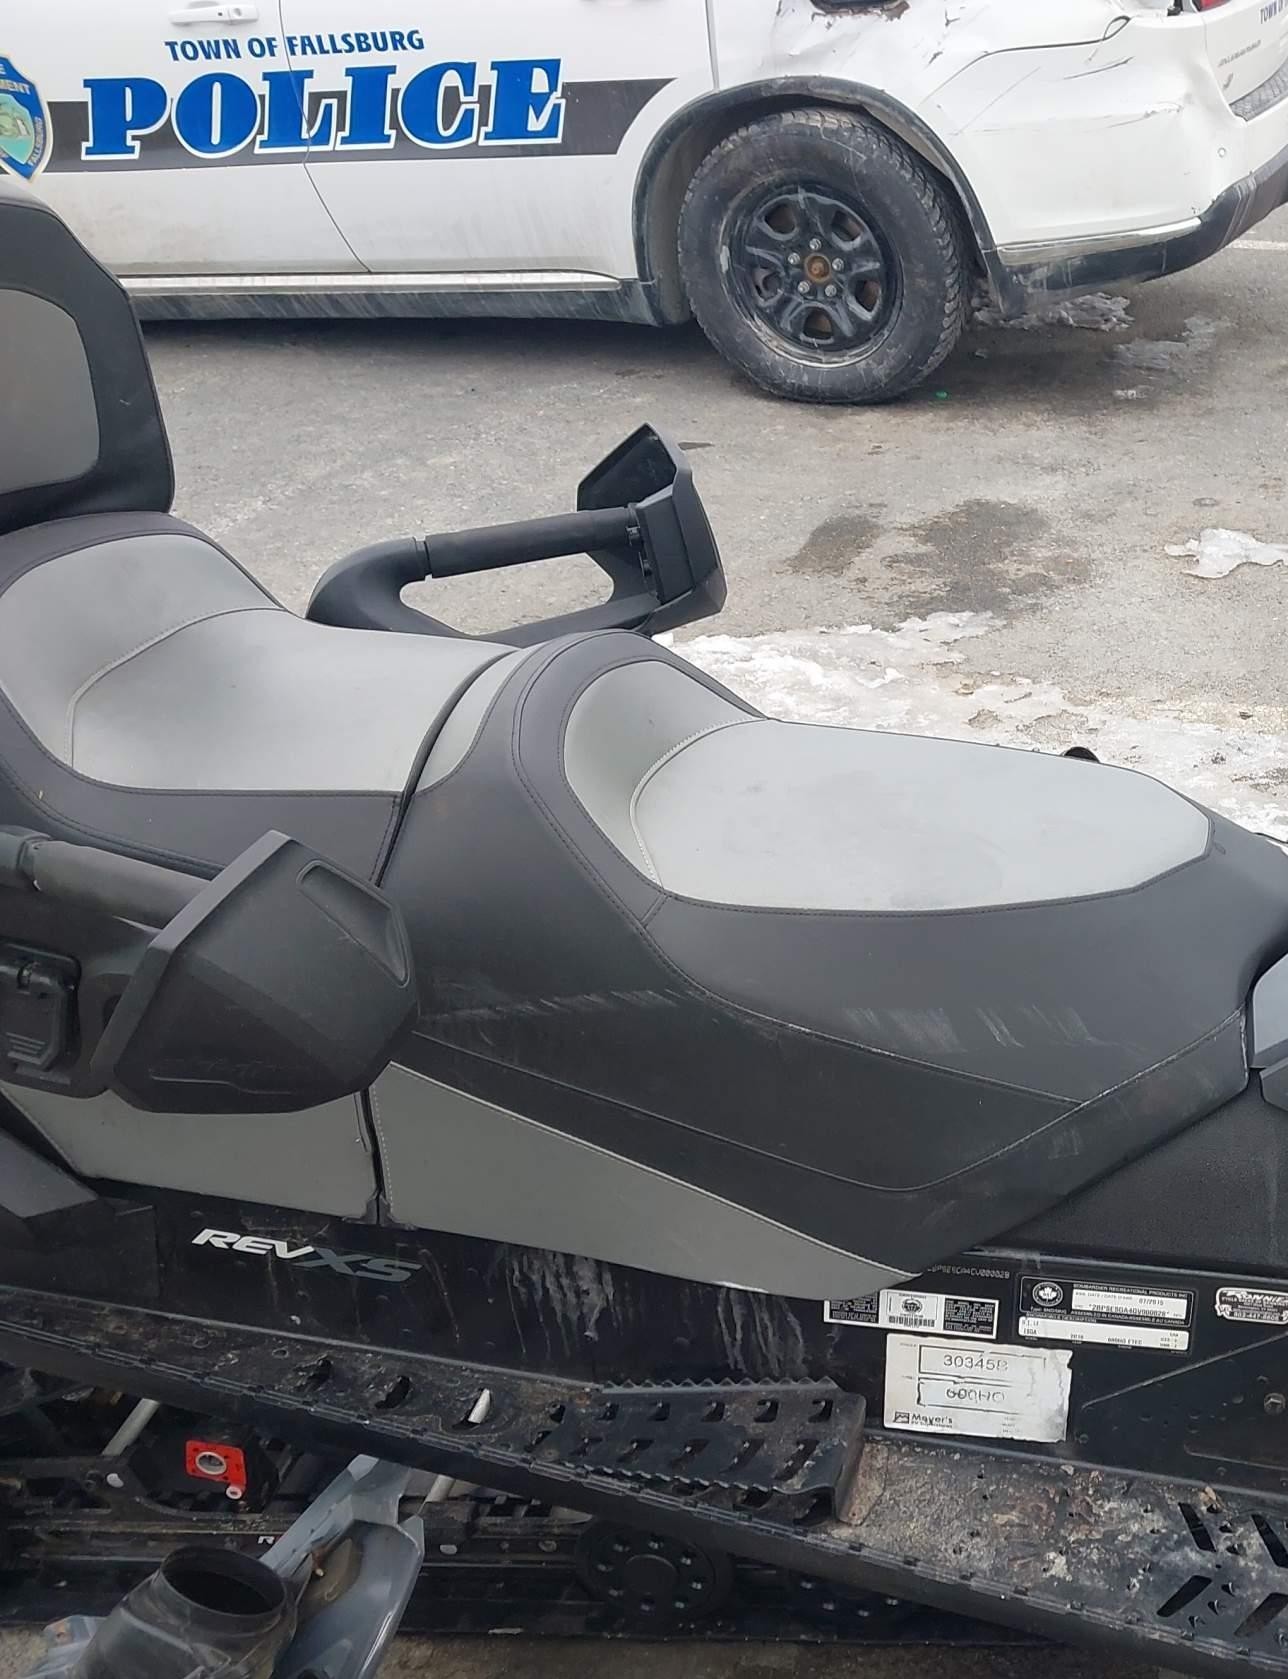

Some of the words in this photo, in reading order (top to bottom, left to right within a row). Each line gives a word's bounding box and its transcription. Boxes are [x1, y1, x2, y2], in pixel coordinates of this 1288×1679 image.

[165, 38, 242, 61] TOWN
[248, 37, 279, 58] OF
[286, 29, 425, 56] FALLSBURG
[82, 58, 566, 160] POLICE
